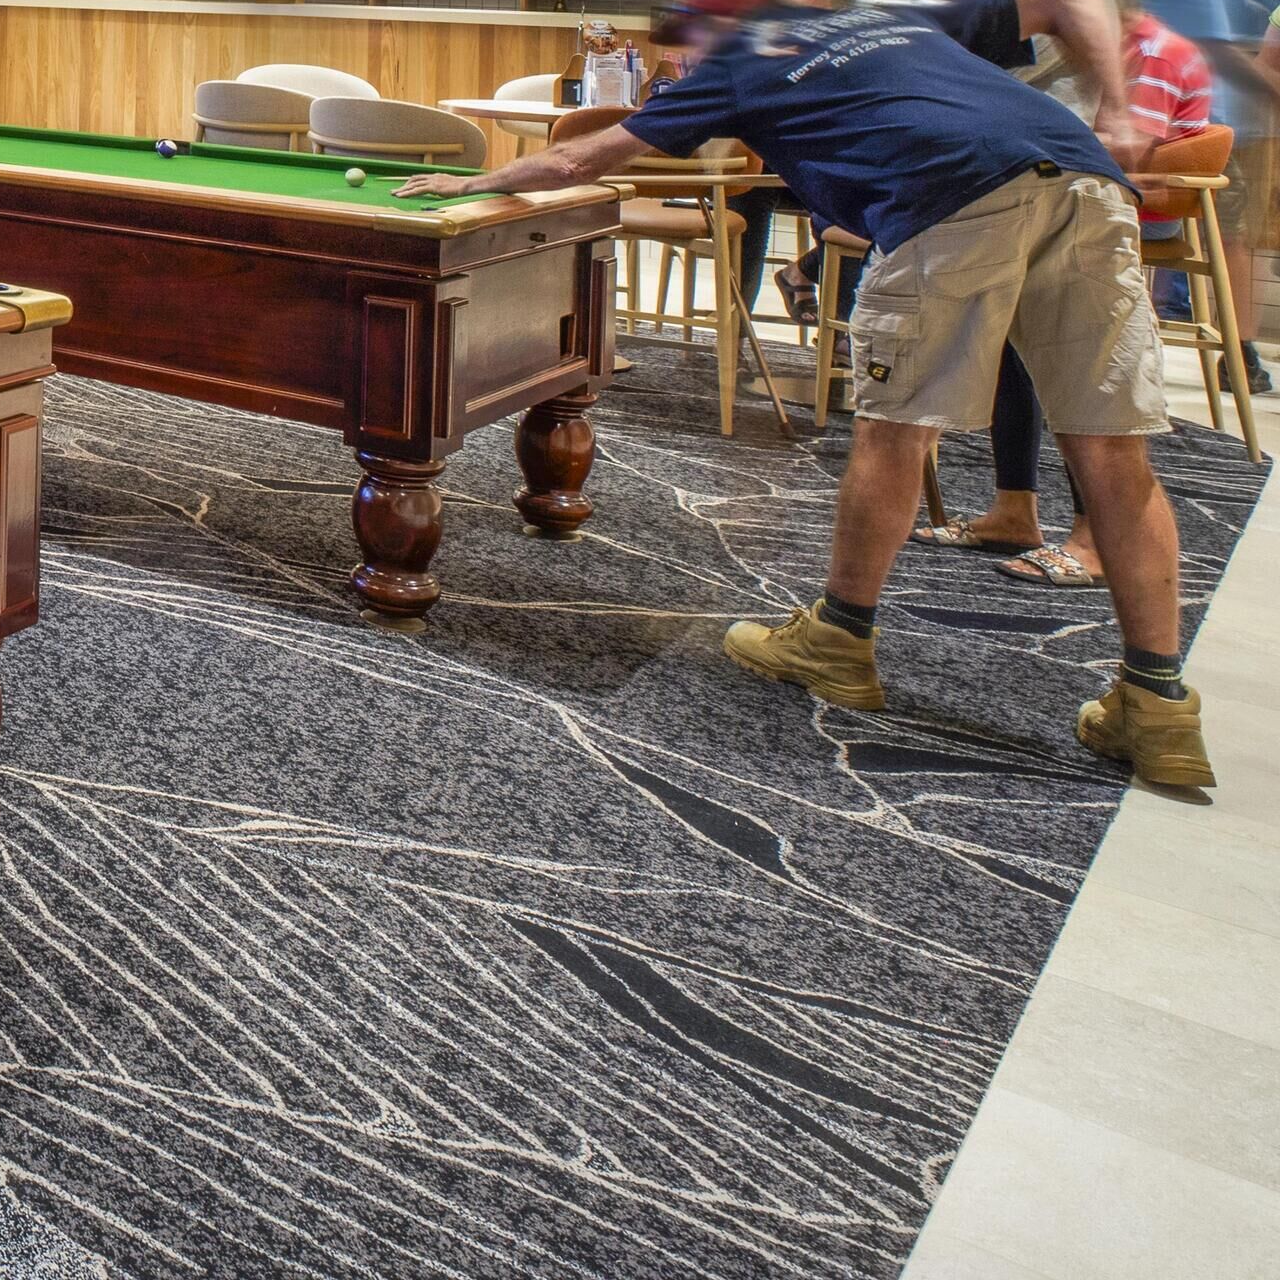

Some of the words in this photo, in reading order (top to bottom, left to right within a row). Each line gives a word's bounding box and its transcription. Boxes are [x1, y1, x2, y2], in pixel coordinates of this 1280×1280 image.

[786, 50, 831, 83] Hervey
[829, 35, 858, 52] Bay
[830, 54, 850, 68] Ph
